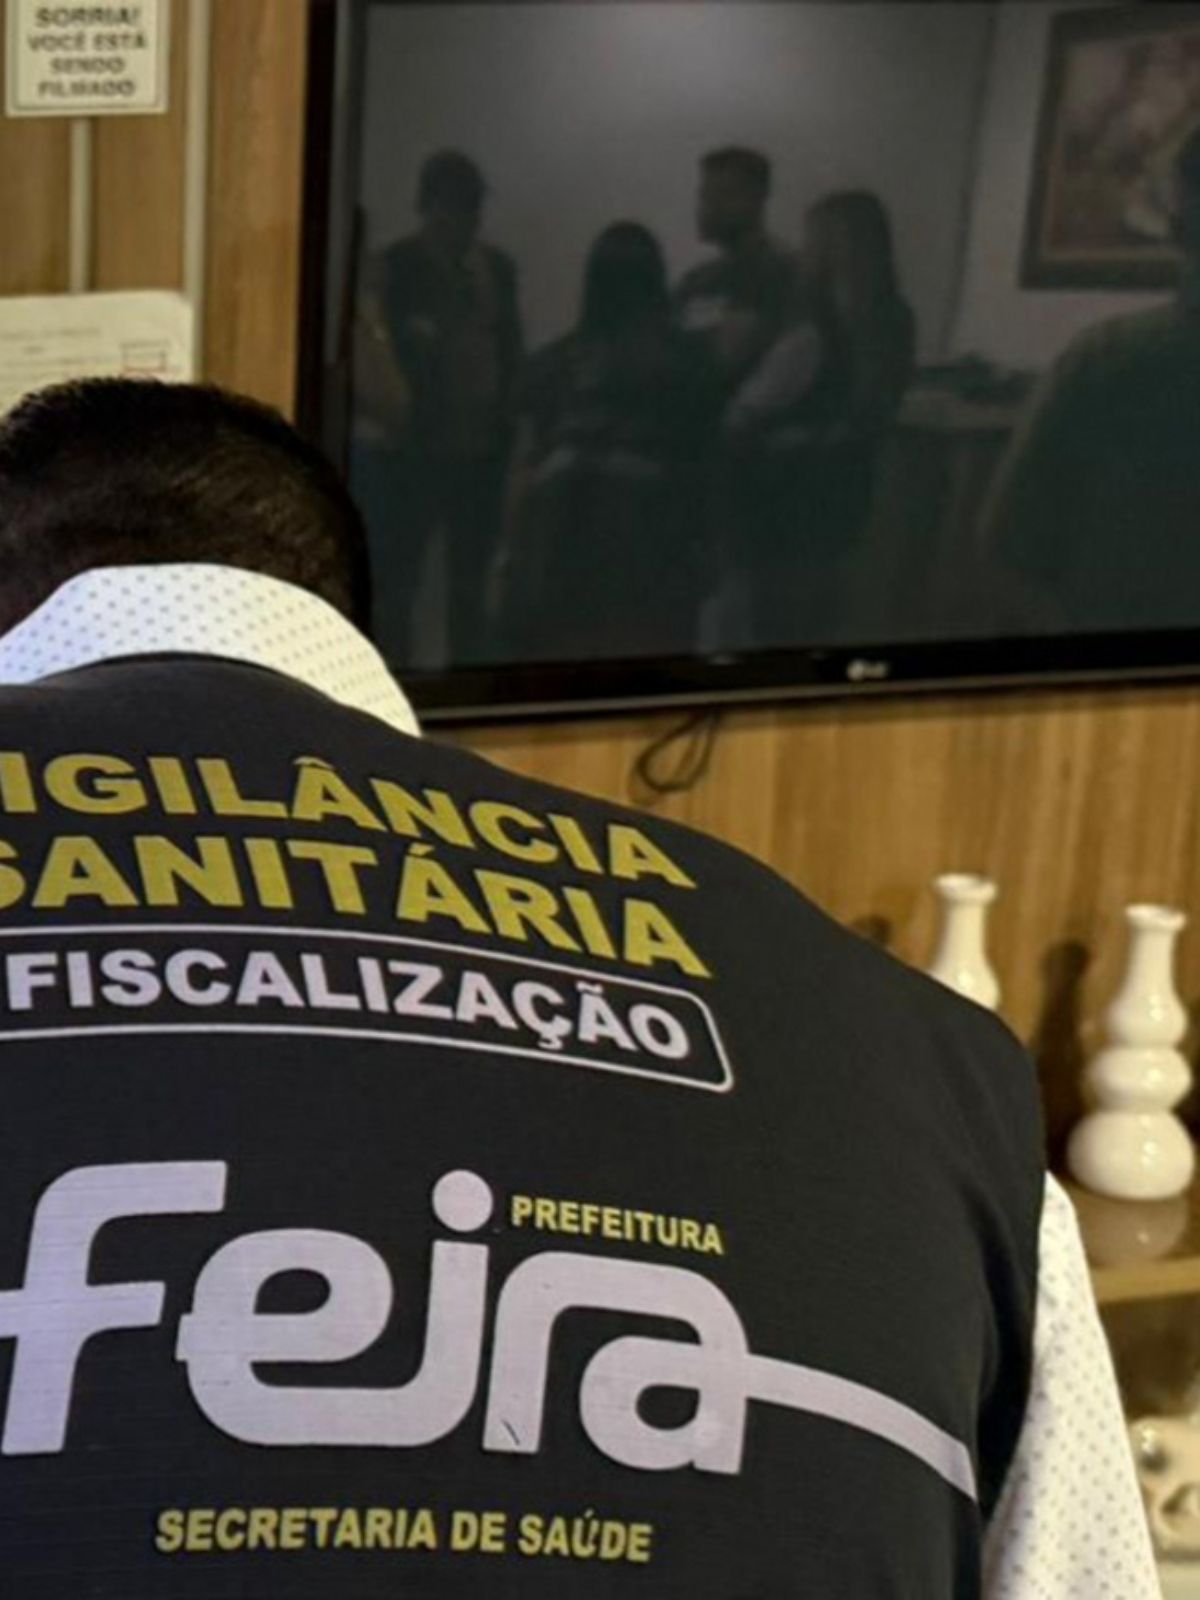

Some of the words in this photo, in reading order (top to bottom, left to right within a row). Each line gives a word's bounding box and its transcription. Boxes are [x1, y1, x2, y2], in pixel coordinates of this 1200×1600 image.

[5, 949, 693, 1061] FISCALIZAÇÃO
[511, 1194, 725, 1256] PREFEITURA
[0, 1160, 750, 1476] feira
[154, 1507, 438, 1552] SECRETARIA
[450, 1511, 506, 1552] DE
[517, 1508, 653, 1563] SAÚDE
